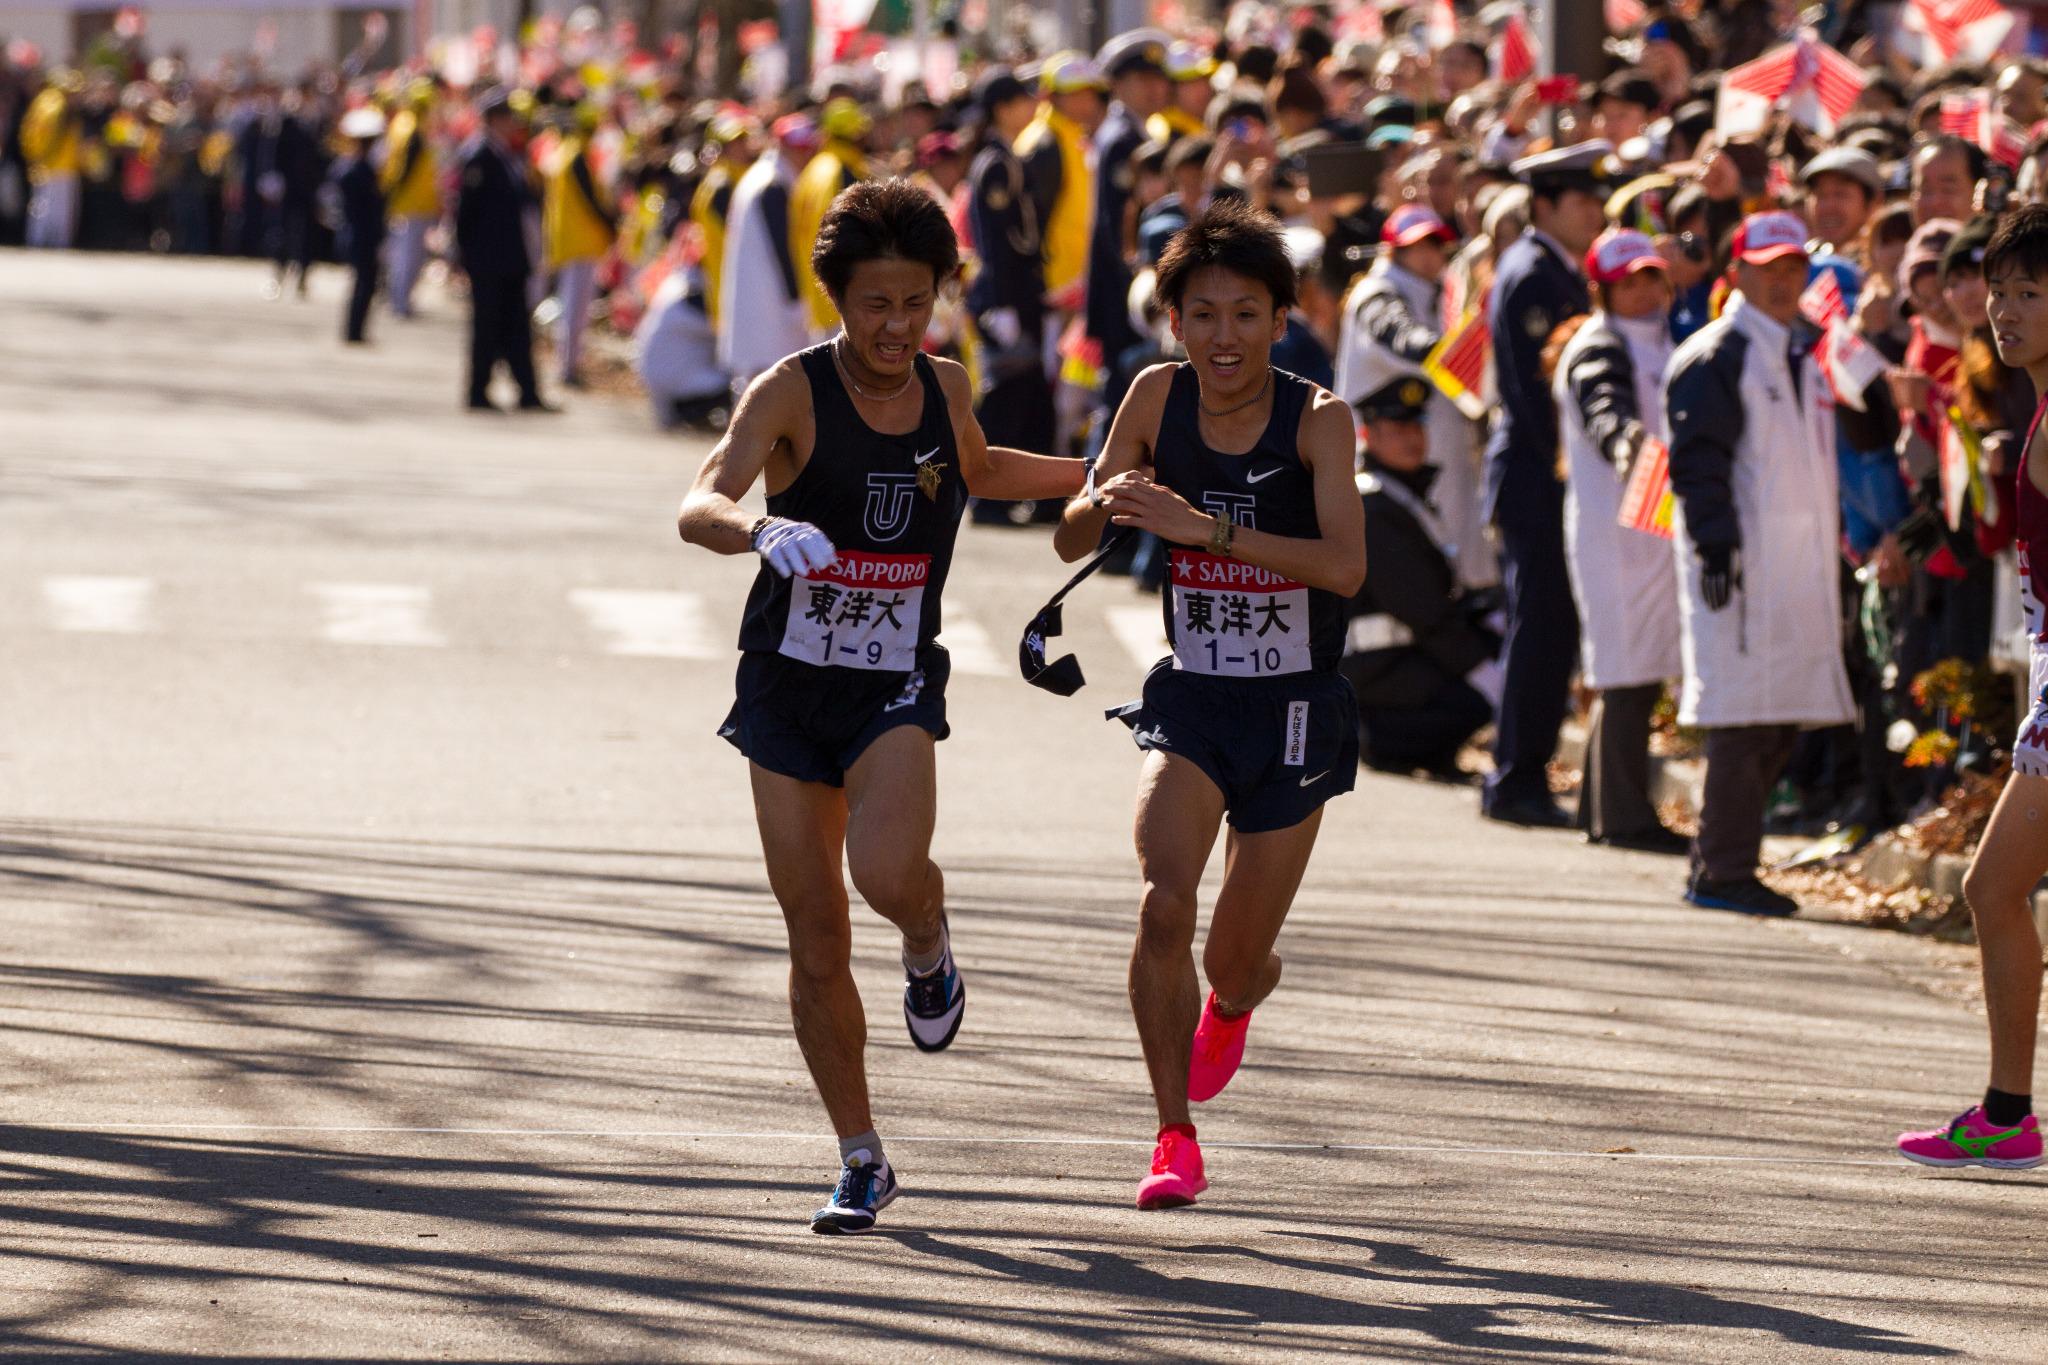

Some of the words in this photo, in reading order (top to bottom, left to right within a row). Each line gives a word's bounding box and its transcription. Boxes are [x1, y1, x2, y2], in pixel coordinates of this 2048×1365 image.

[830, 557, 927, 582] SAPPORO
[1199, 561, 1297, 586] SAPPOR
[805, 583, 906, 631] 東洋大
[1184, 591, 1291, 638] 東洋大
[1289, 705, 1303, 762] がんばろう日本
